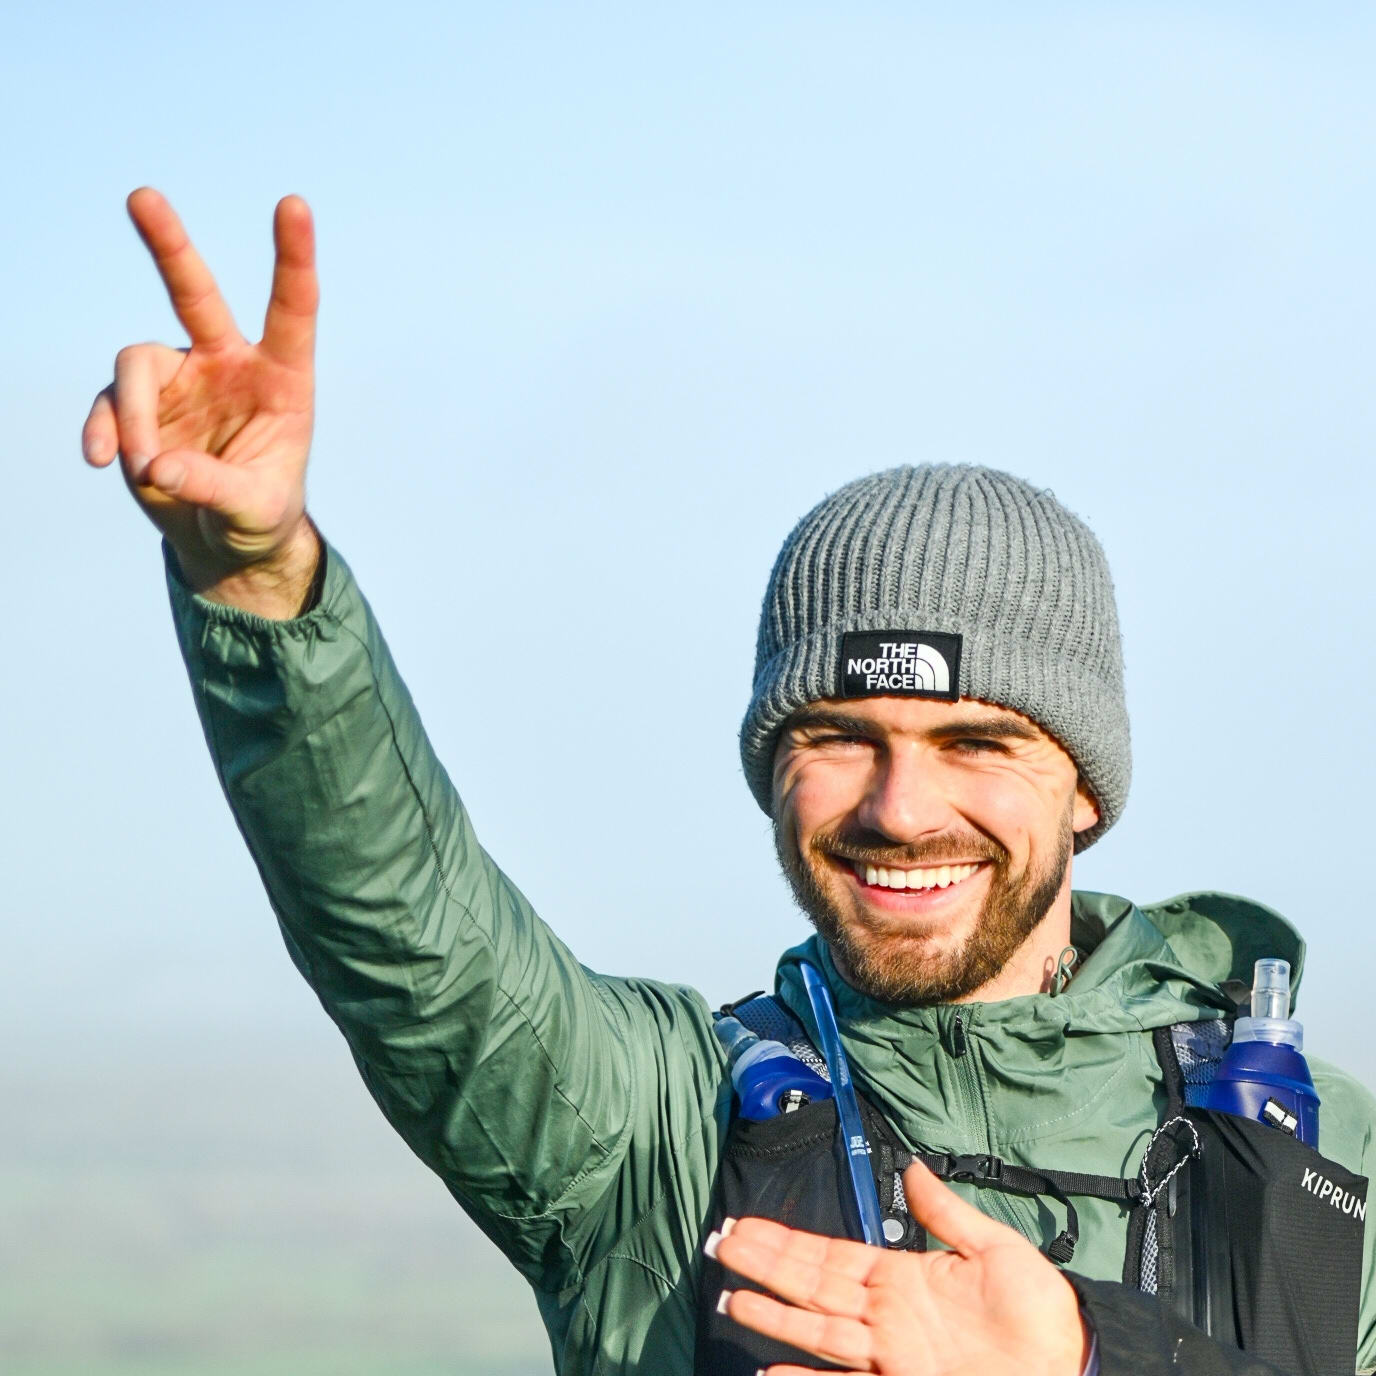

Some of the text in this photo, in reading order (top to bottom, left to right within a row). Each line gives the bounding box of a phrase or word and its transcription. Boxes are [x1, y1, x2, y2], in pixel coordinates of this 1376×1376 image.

[879, 643, 917, 659] THE
[847, 658, 915, 674] NORTH
[866, 674, 915, 690] FACE
[1300, 1167, 1368, 1222] KIPRUN
